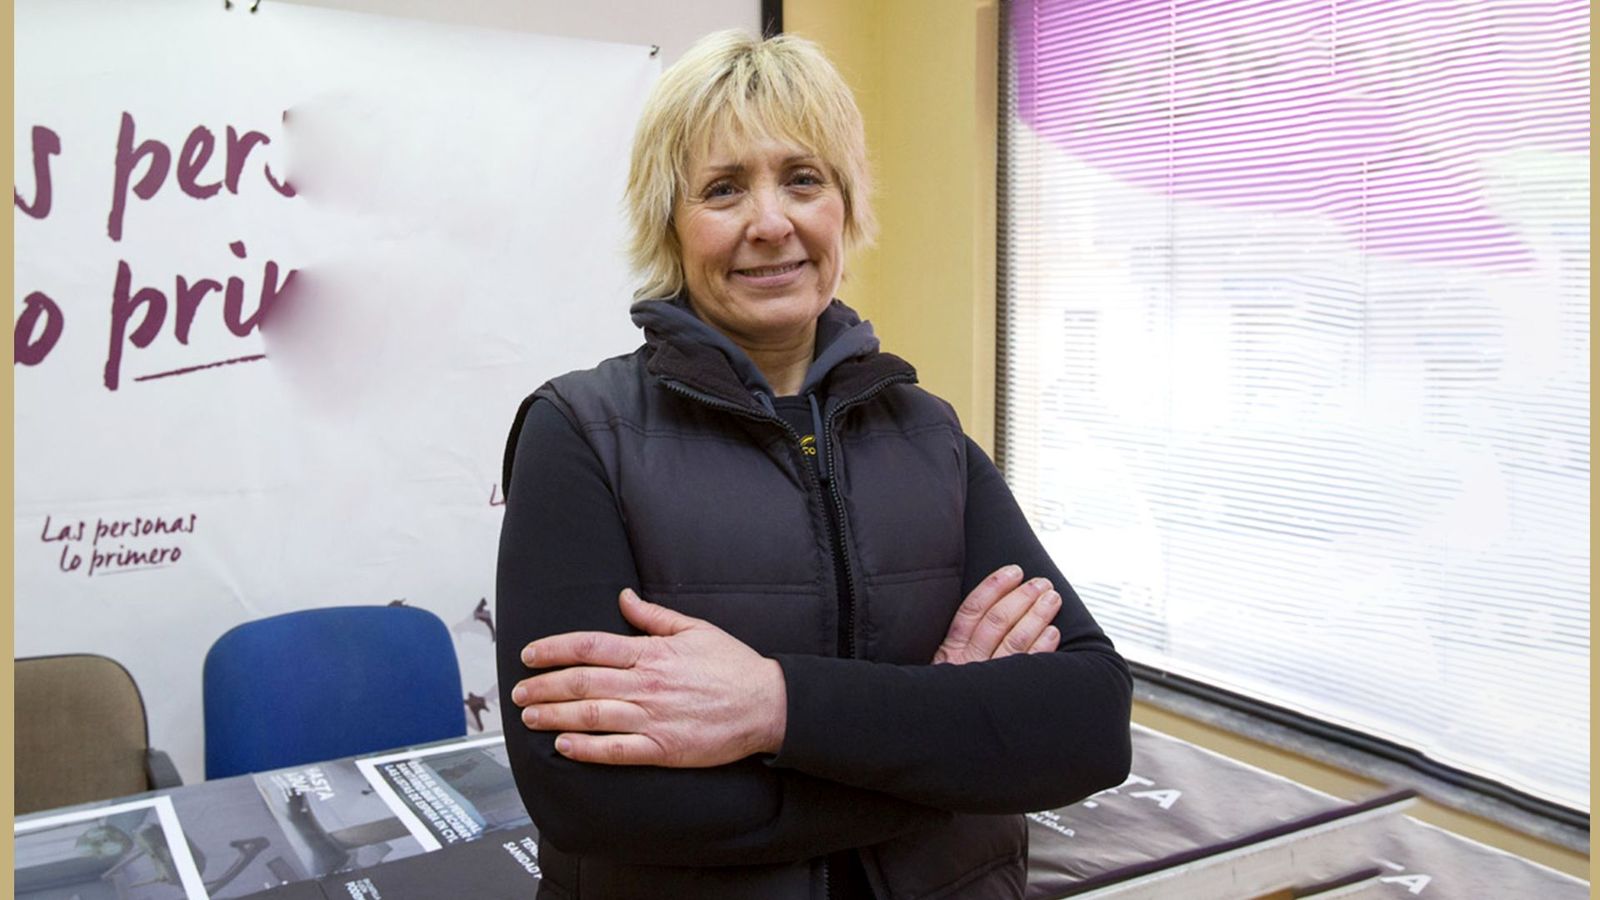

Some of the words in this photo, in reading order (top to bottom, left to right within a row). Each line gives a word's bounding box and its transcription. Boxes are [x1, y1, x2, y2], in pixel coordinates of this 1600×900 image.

[41, 515, 85, 542] Las
[93, 513, 197, 546] personas
[59, 544, 82, 572] lo
[88, 544, 182, 577] primero
[503, 842, 540, 874] SANIDAD
